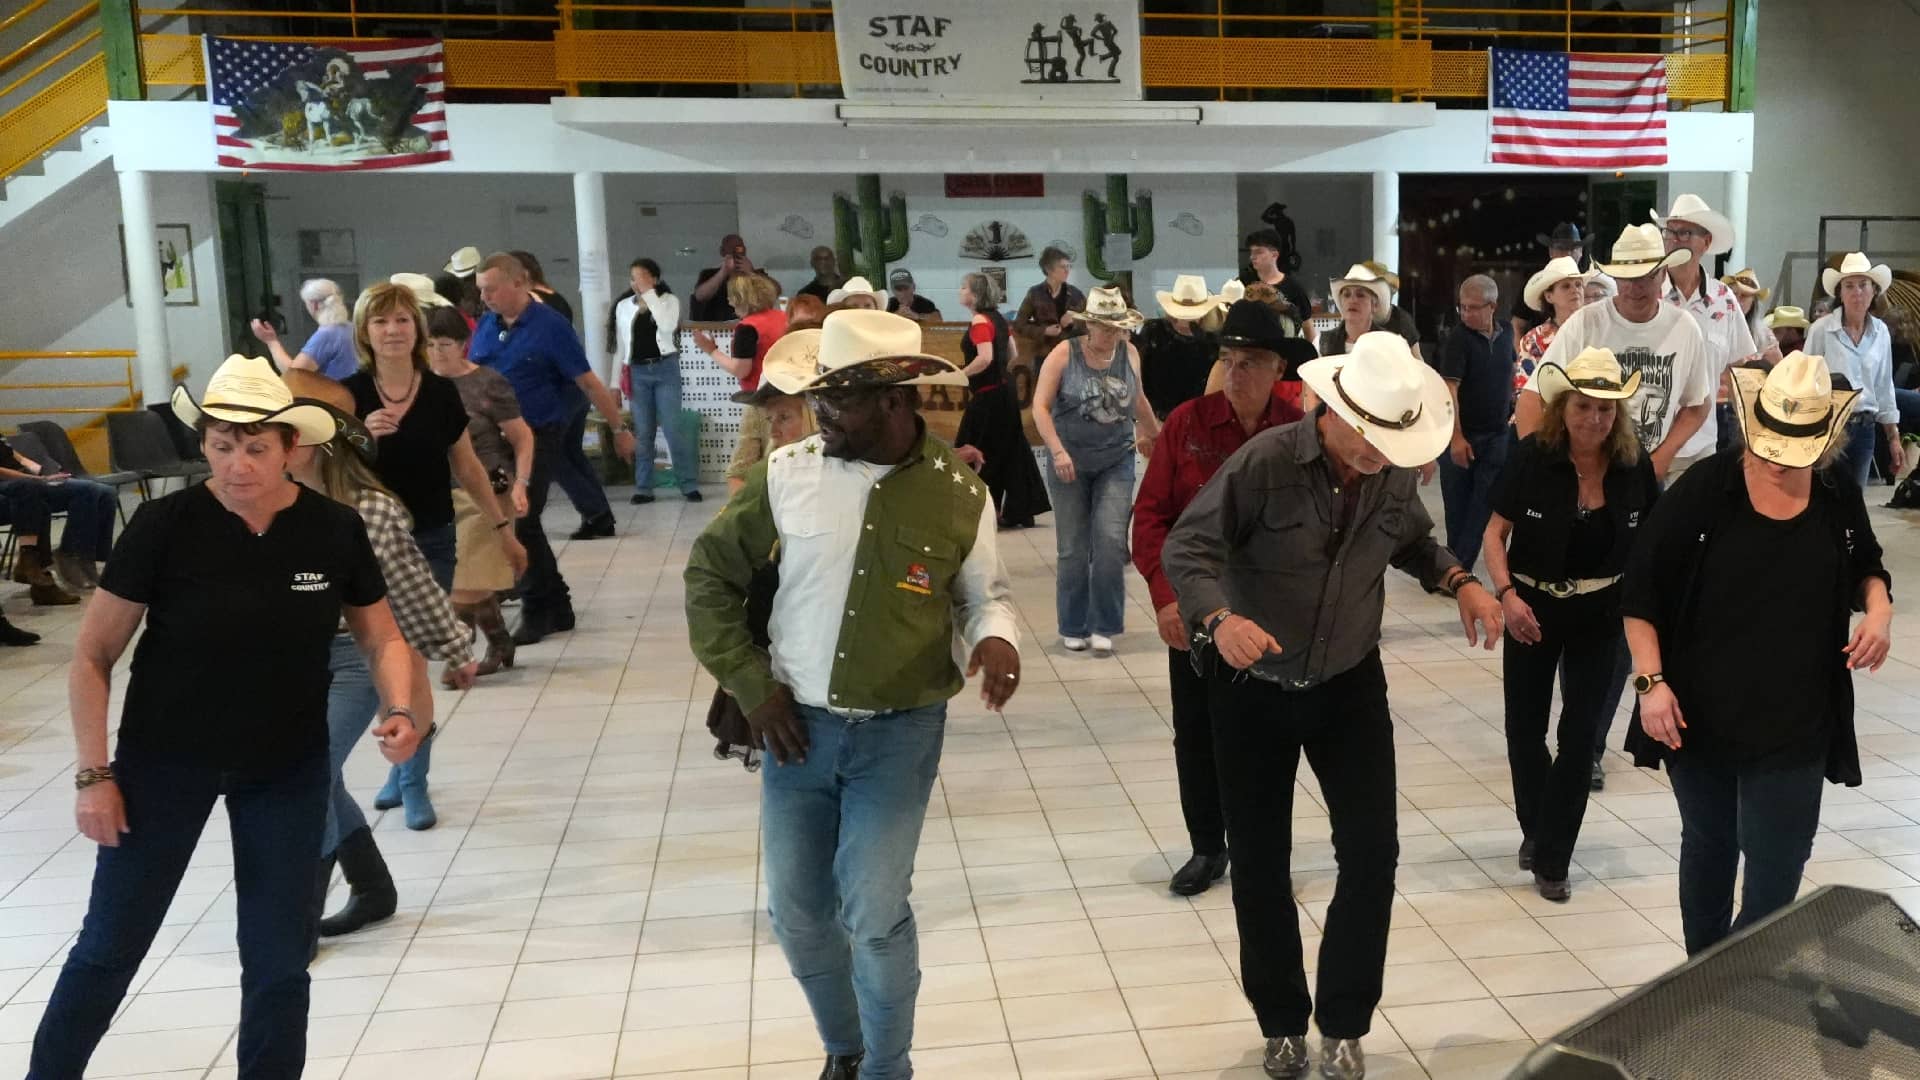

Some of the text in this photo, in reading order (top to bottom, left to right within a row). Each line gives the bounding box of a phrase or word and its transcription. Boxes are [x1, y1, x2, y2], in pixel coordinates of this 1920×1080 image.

[869, 15, 951, 37] STAF
[860, 54, 962, 78] COUNTRY
[290, 582, 329, 591] COUNTRY
